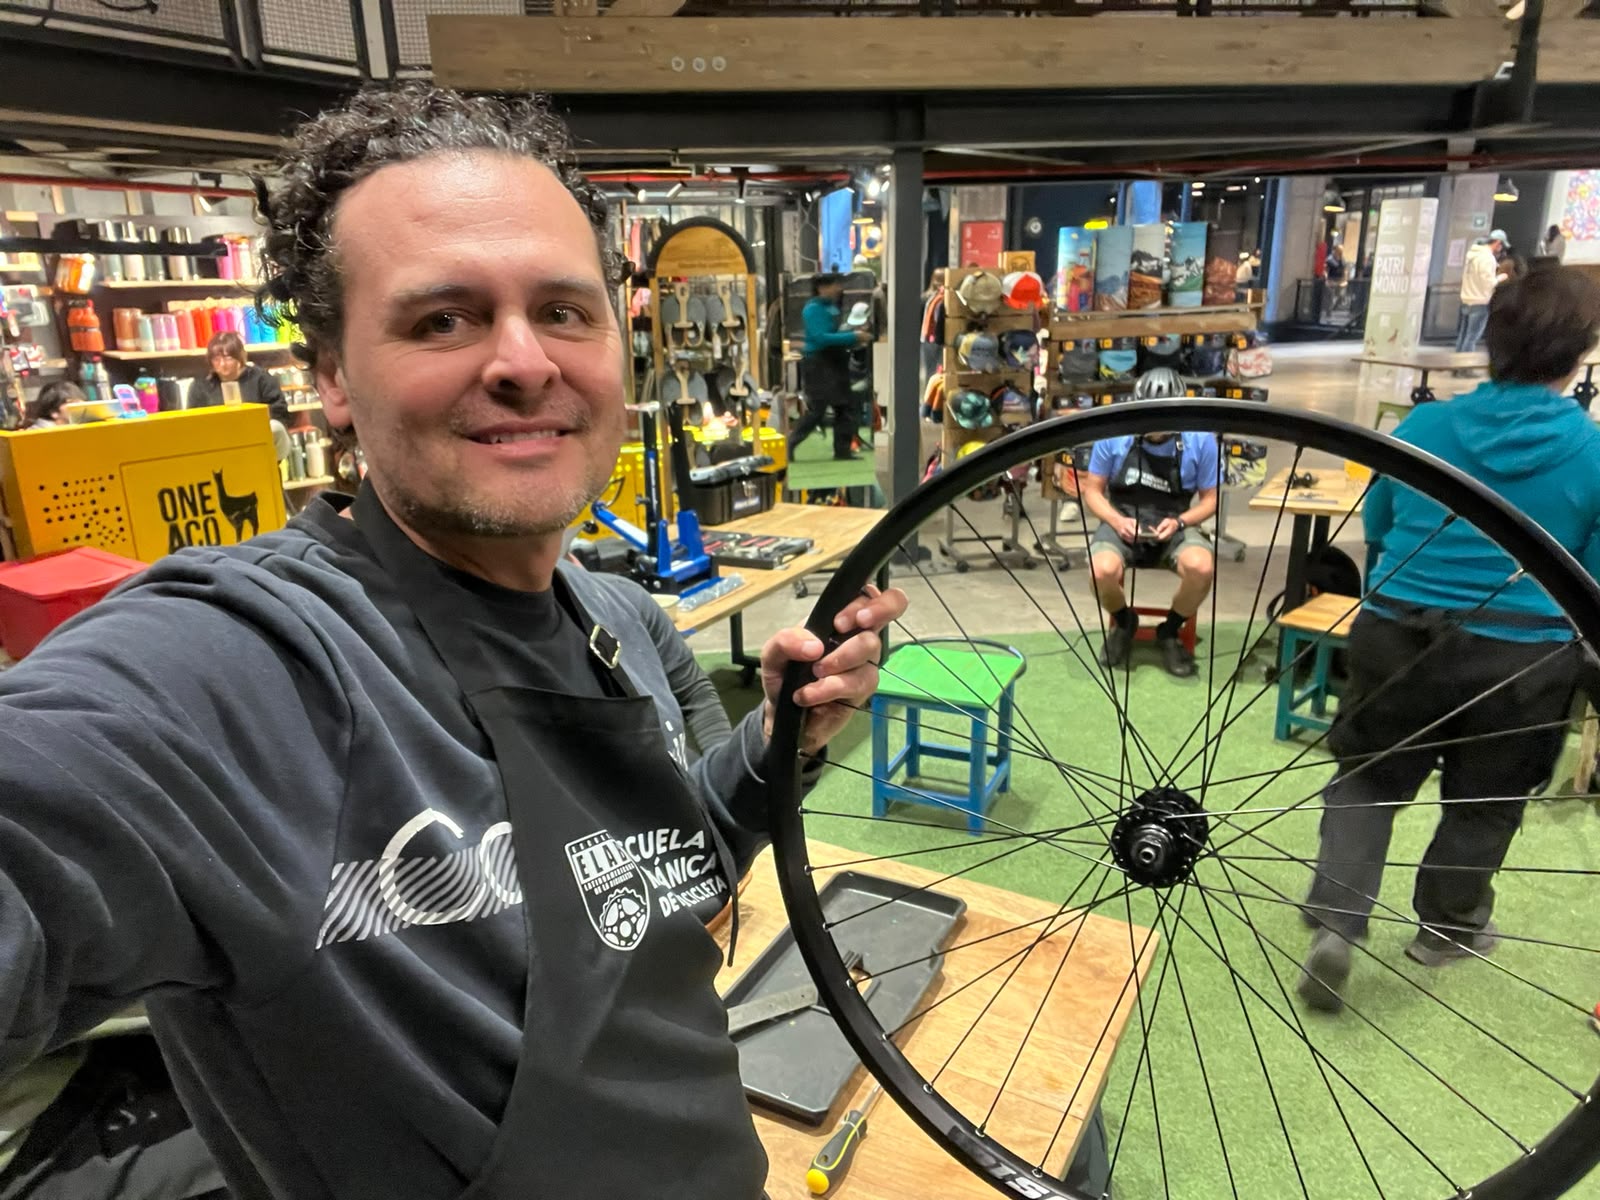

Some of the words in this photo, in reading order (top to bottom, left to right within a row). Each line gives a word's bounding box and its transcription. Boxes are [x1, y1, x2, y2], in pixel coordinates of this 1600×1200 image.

[1375, 256, 1405, 274] PATRI
[1372, 275, 1409, 294] MONIO
[157, 480, 216, 523] ONE
[640, 852, 717, 890] ÁNICA
[658, 892, 681, 918] DE
